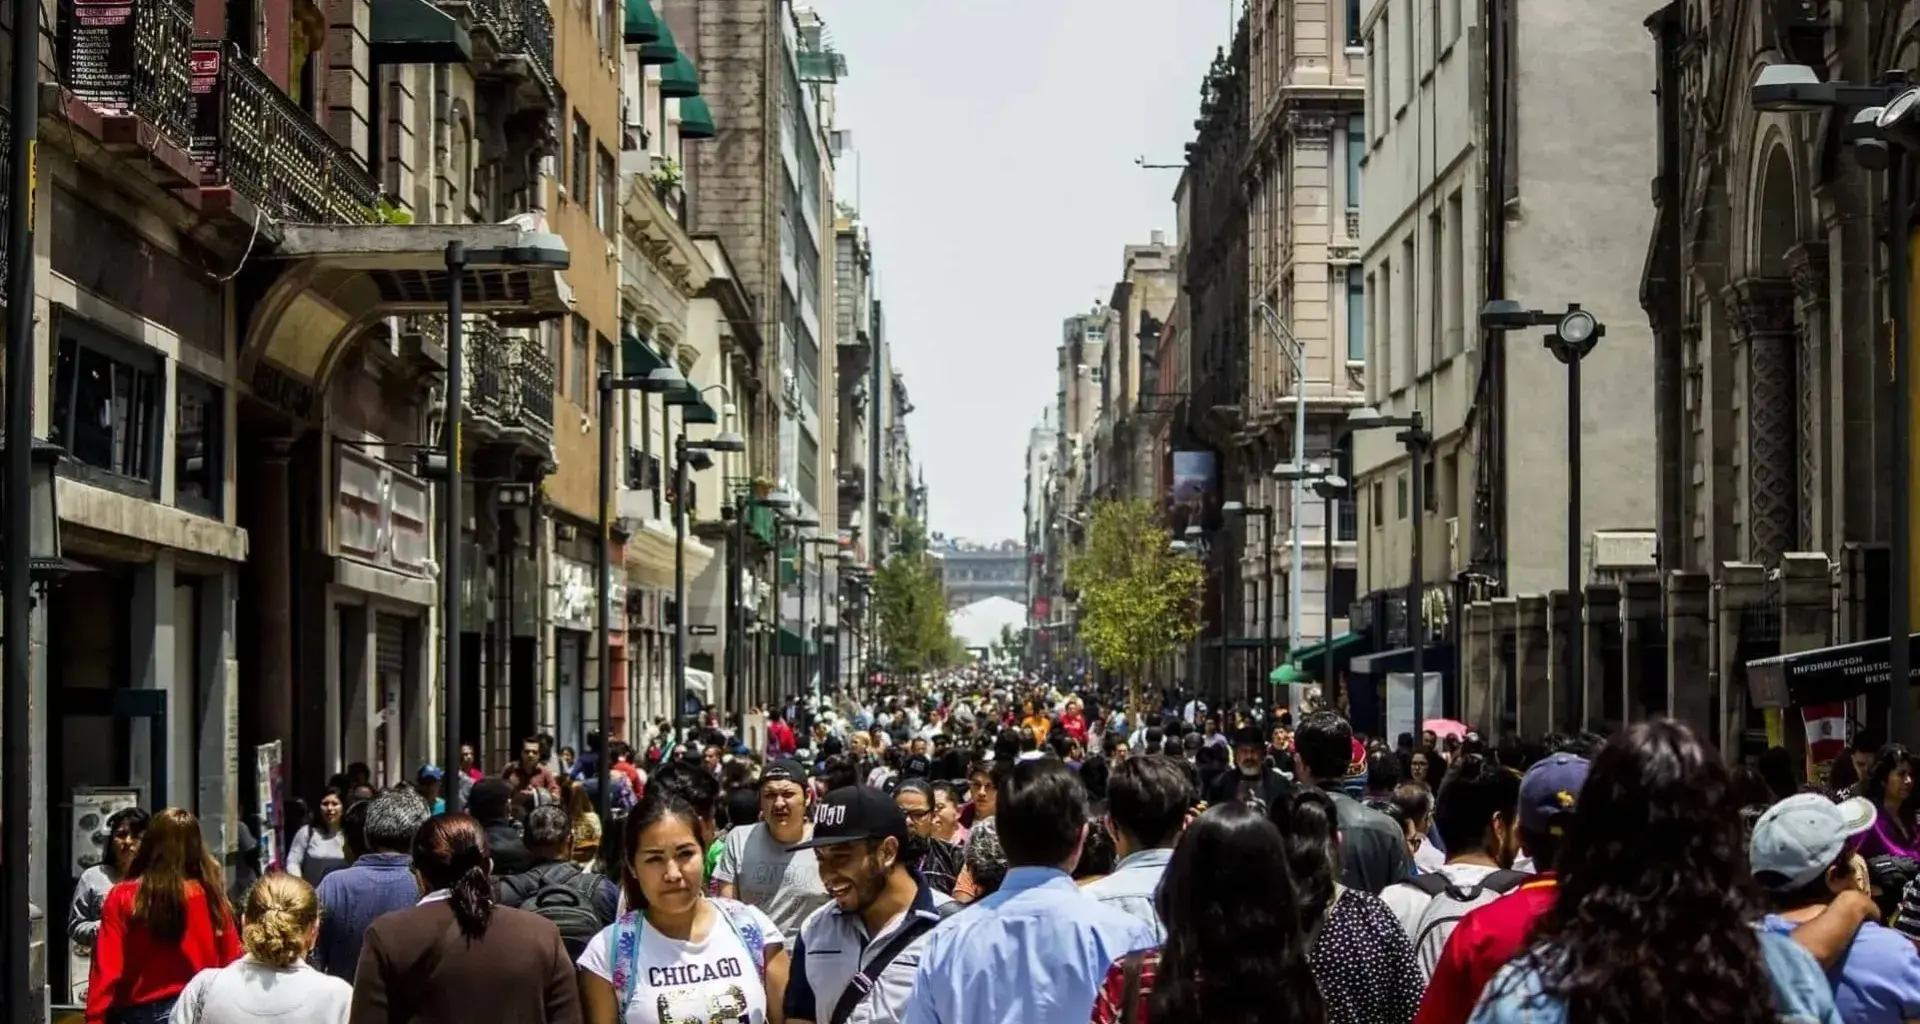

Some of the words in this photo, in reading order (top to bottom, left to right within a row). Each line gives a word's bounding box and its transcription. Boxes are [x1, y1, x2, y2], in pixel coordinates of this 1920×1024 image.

[1793, 656, 1863, 675] INFORMACION
[1843, 662, 1892, 675] TURISTIC
[649, 957, 742, 987] CHICAGO
